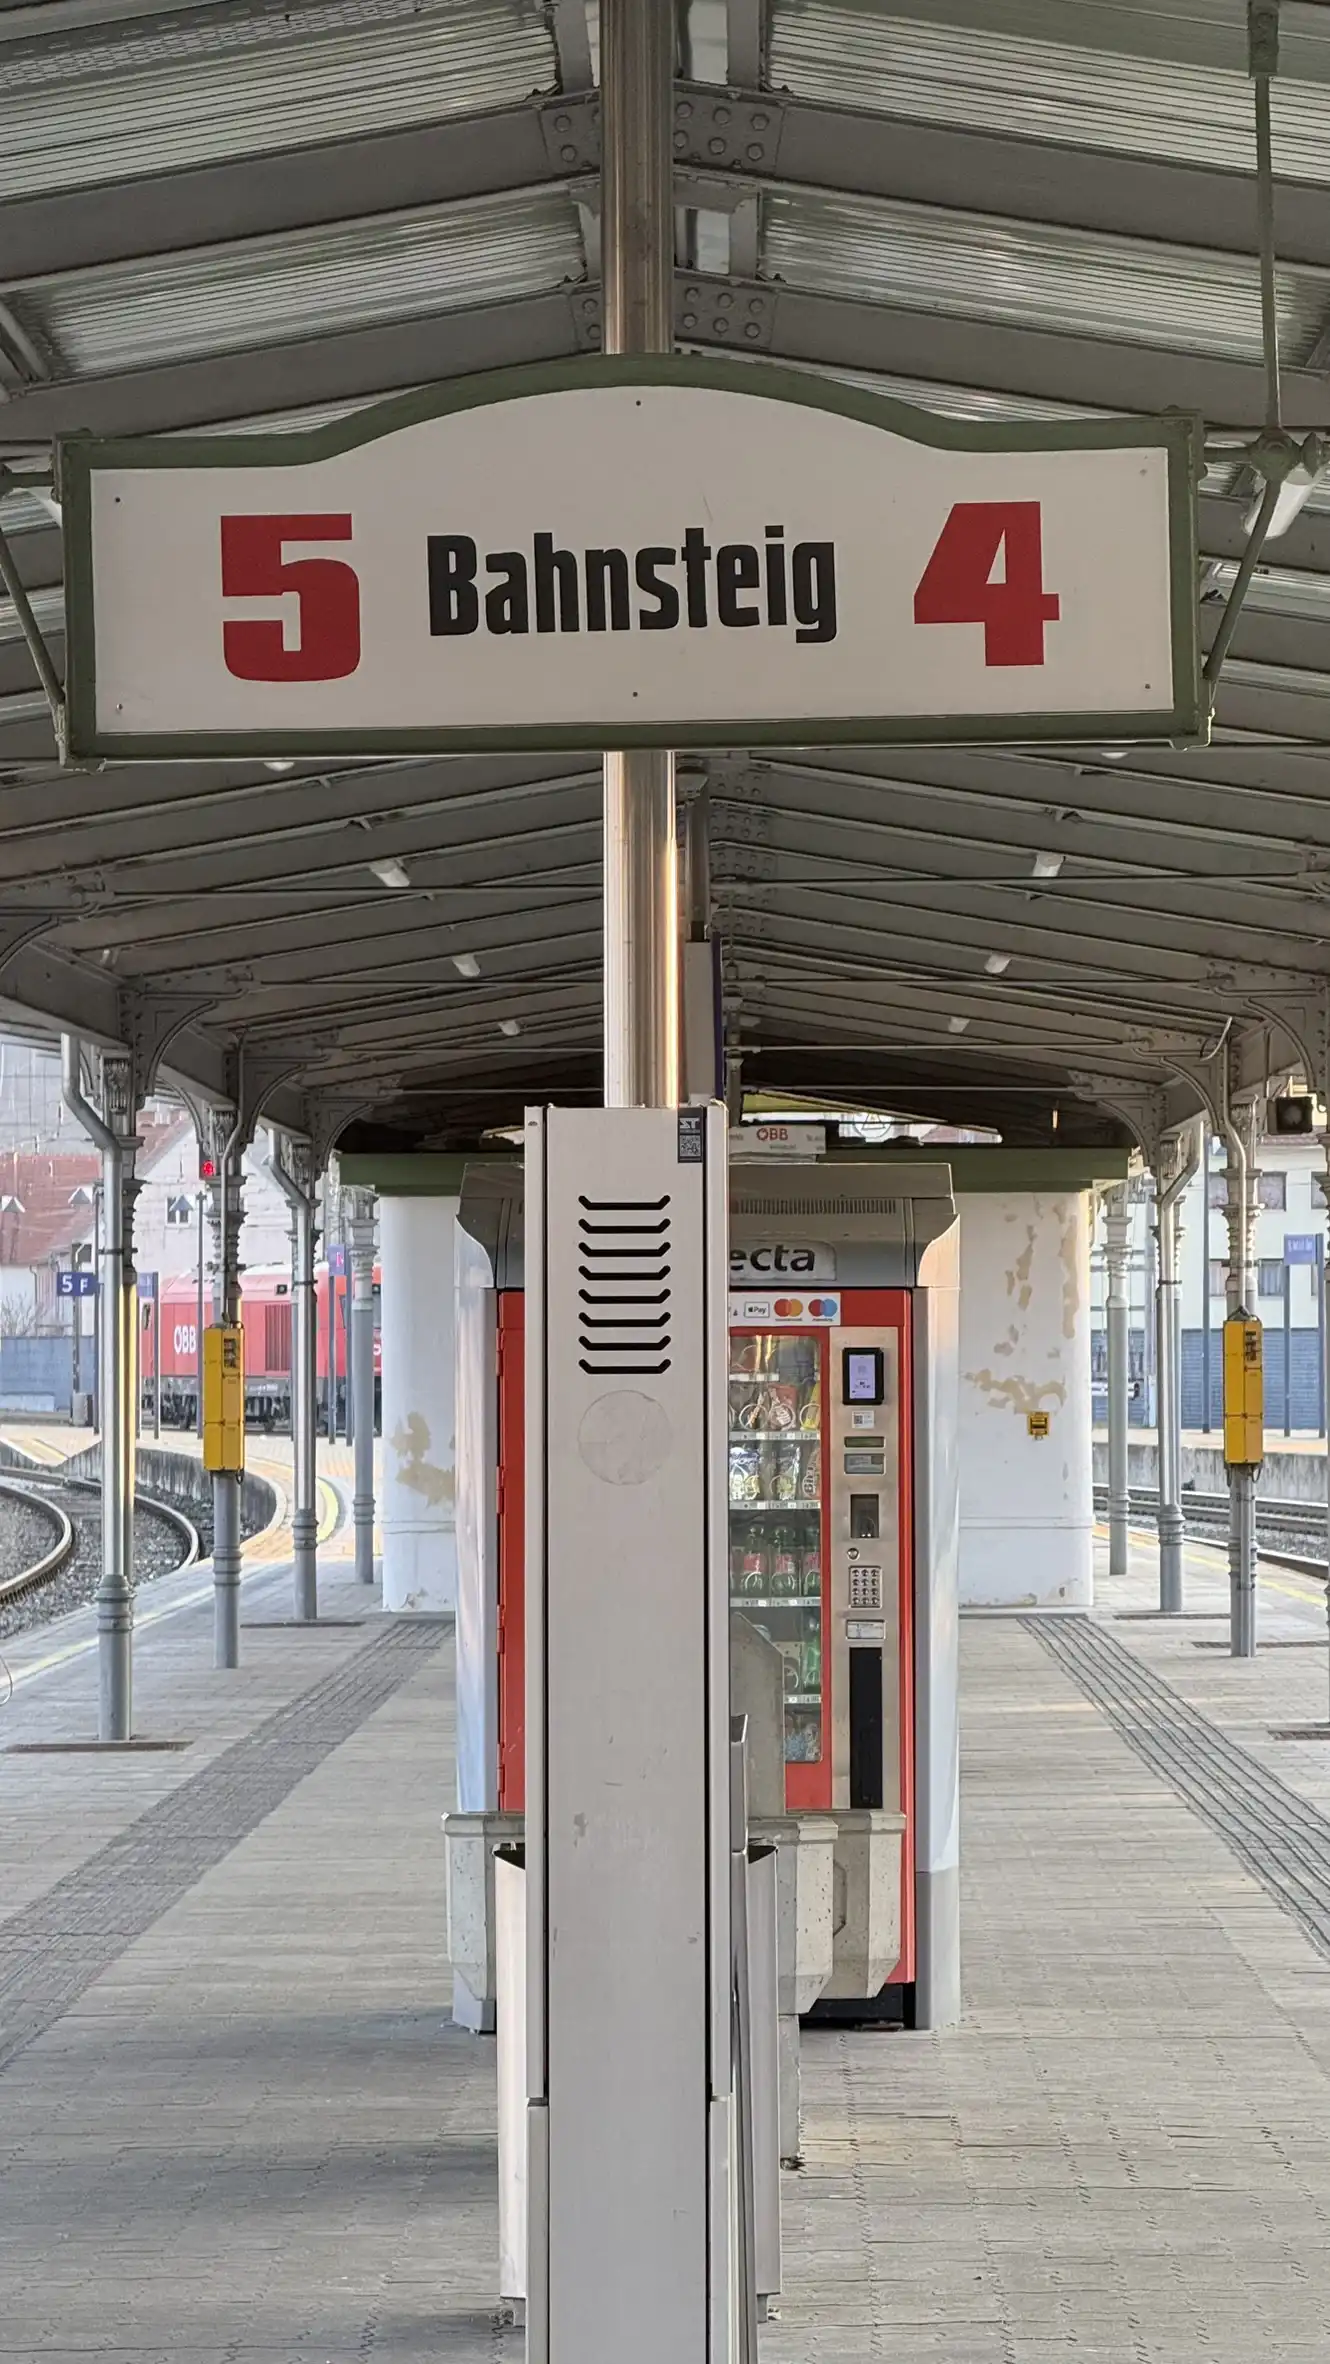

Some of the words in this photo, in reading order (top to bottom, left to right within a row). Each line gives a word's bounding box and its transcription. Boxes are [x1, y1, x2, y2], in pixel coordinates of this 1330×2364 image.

[221, 515, 360, 682] 5
[428, 525, 836, 643] Bahnsteig
[915, 502, 1060, 666] 4
[62, 1274, 73, 1292] 5
[80, 1278, 88, 1293] F
